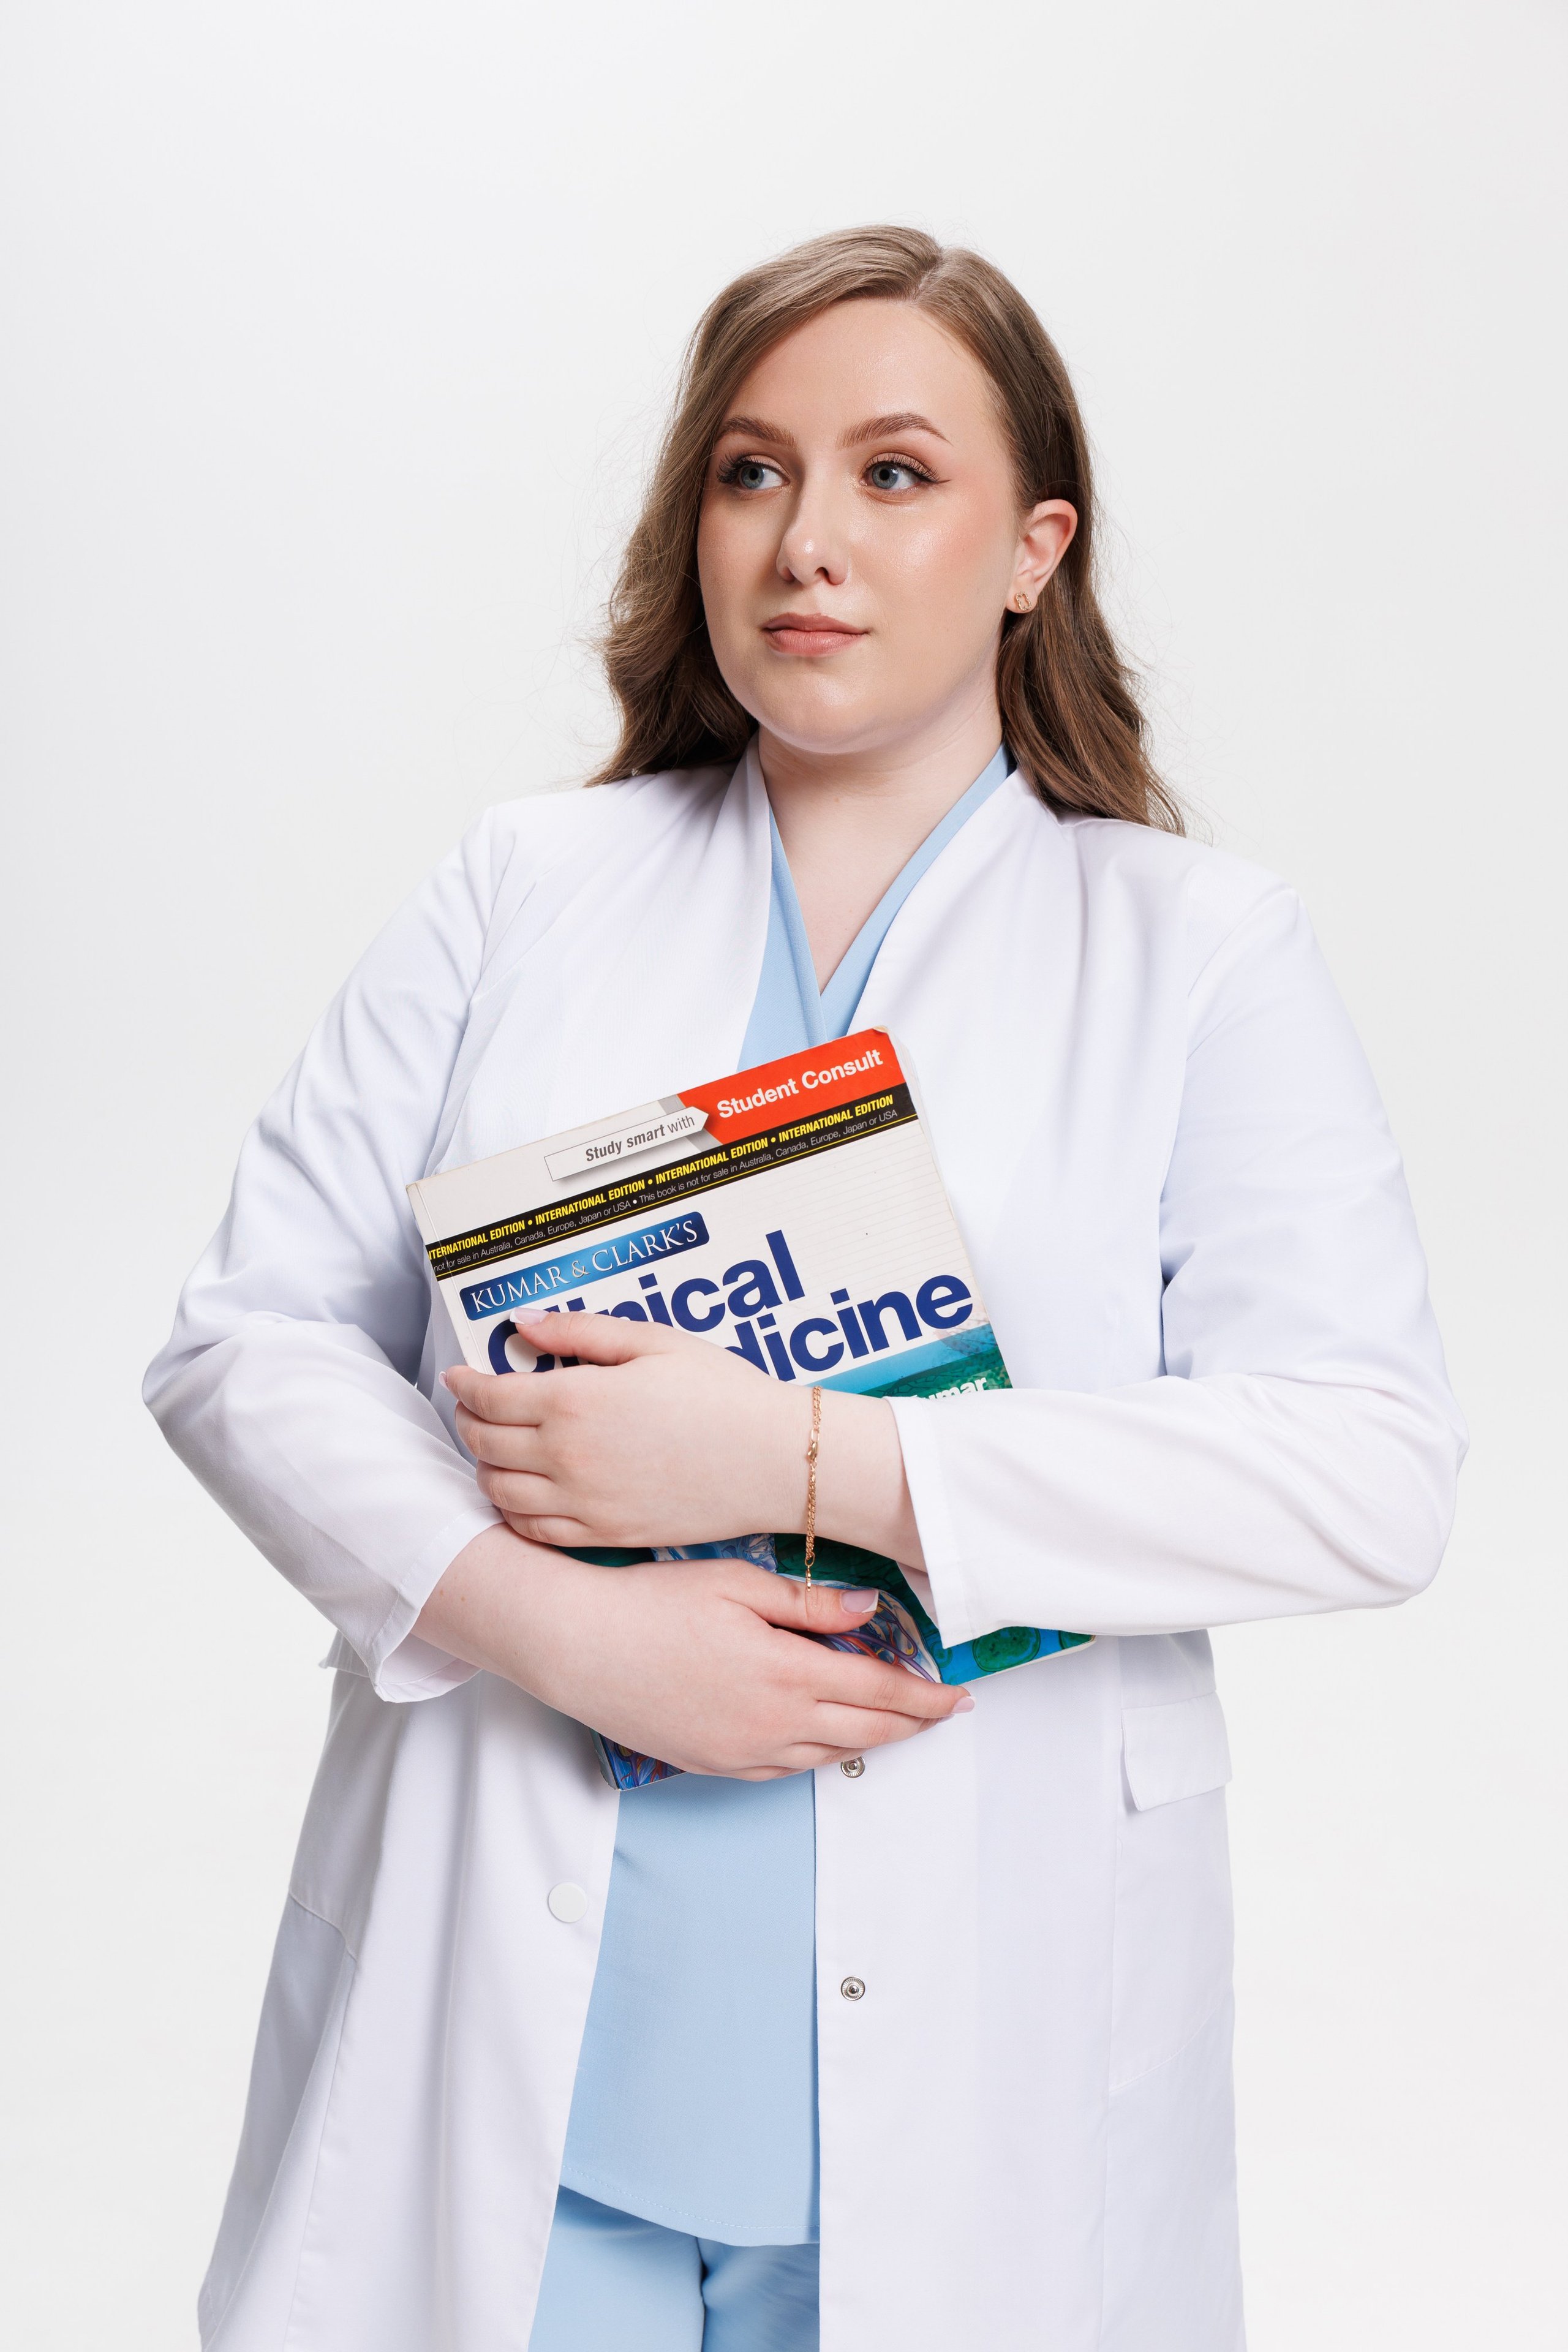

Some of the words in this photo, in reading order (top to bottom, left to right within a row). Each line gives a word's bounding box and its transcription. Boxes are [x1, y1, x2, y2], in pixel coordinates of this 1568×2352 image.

[717, 1079, 799, 1118] Student
[801, 1049, 883, 1089] Consult
[489, 1219, 526, 1239] EDITION
[535, 1193, 606, 1224] INTERNATIONAL
[608, 1179, 646, 1200] EDITION
[655, 1151, 729, 1184] INTERNATIONAL
[730, 1137, 769, 1158] EDITION
[778, 1109, 854, 1142] INTERNATIONAL
[854, 1094, 894, 1116] EDITION
[586, 1140, 622, 1162] Study
[627, 1124, 665, 1147] smart
[667, 1115, 695, 1133] with
[434, 1262, 445, 1272] not
[447, 1260, 455, 1268] for
[457, 1254, 471, 1265] sale
[481, 1241, 513, 1257] Australia,
[514, 1230, 546, 1246] Canada,
[547, 1220, 576, 1235] Europe,
[578, 1211, 602, 1225] Japan
[612, 1200, 631, 1213] USA
[638, 1192, 655, 1204] This
[657, 1185, 677, 1199] book
[686, 1177, 699, 1188] not
[700, 1173, 711, 1183] for
[713, 1168, 729, 1179] sale
[739, 1153, 774, 1170] Australia,
[775, 1142, 809, 1157] Canada,
[810, 1131, 841, 1147] Europe,
[843, 1120, 867, 1136] Japan
[869, 1117, 877, 1126] or
[878, 1109, 898, 1122] USA
[470, 1267, 570, 1313] KUMAR
[571, 1260, 590, 1278] &
